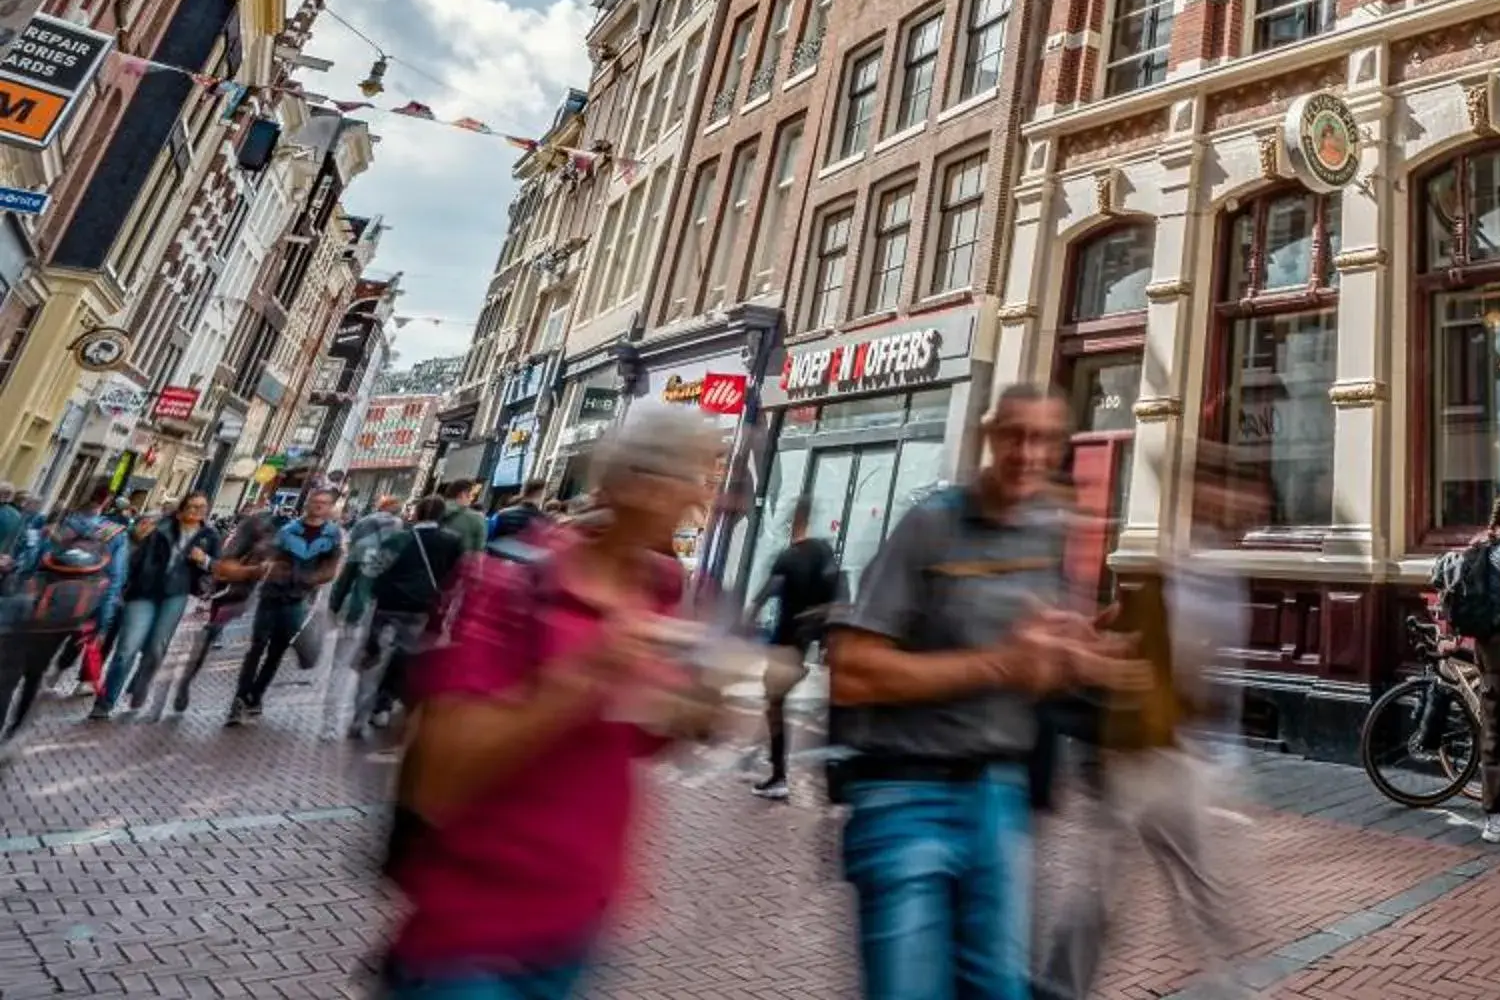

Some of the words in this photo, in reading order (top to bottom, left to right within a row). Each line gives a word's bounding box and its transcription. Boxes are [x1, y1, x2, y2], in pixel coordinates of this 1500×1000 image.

[24, 25, 92, 56] REPAIR
[829, 344, 856, 383] EN
[704, 379, 742, 411] illy
[1100, 394, 1120, 409] 100
